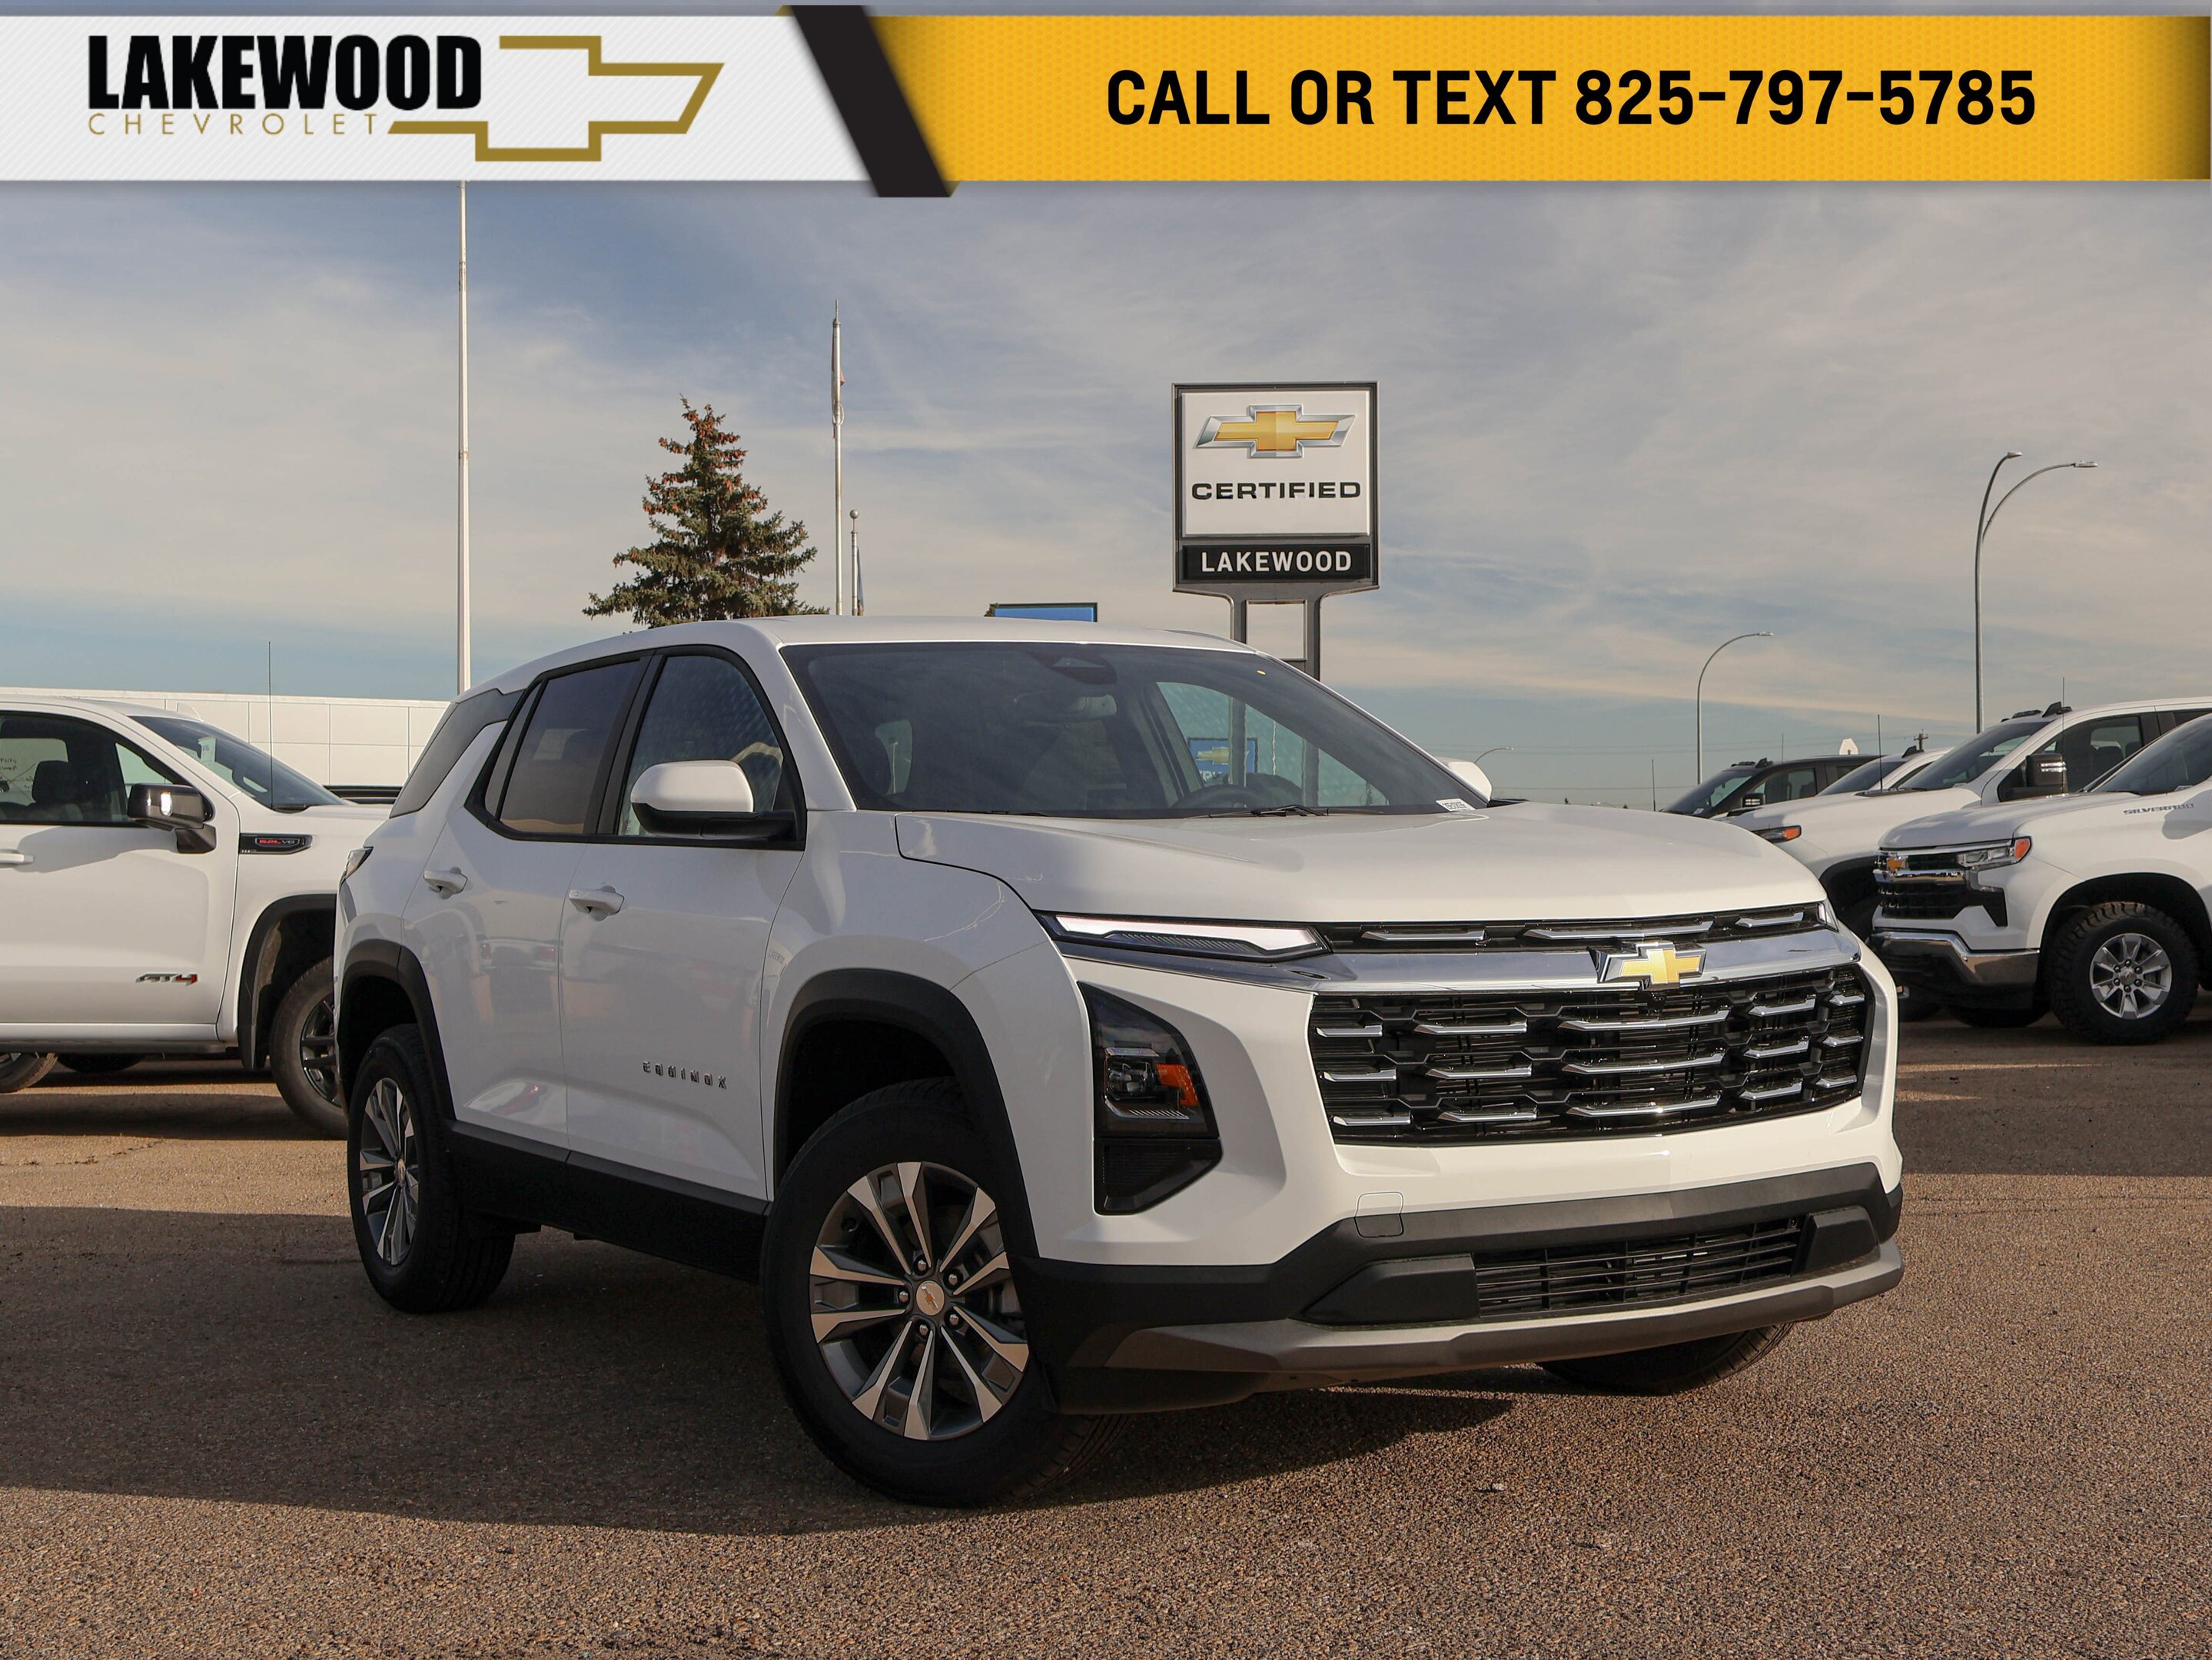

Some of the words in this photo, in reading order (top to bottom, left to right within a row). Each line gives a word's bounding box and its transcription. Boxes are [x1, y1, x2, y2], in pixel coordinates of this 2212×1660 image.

[1191, 482, 1360, 500] CERTIFIED
[1201, 551, 1352, 572] LAKEWOOD
[643, 1061, 727, 1089] EQUINOX
